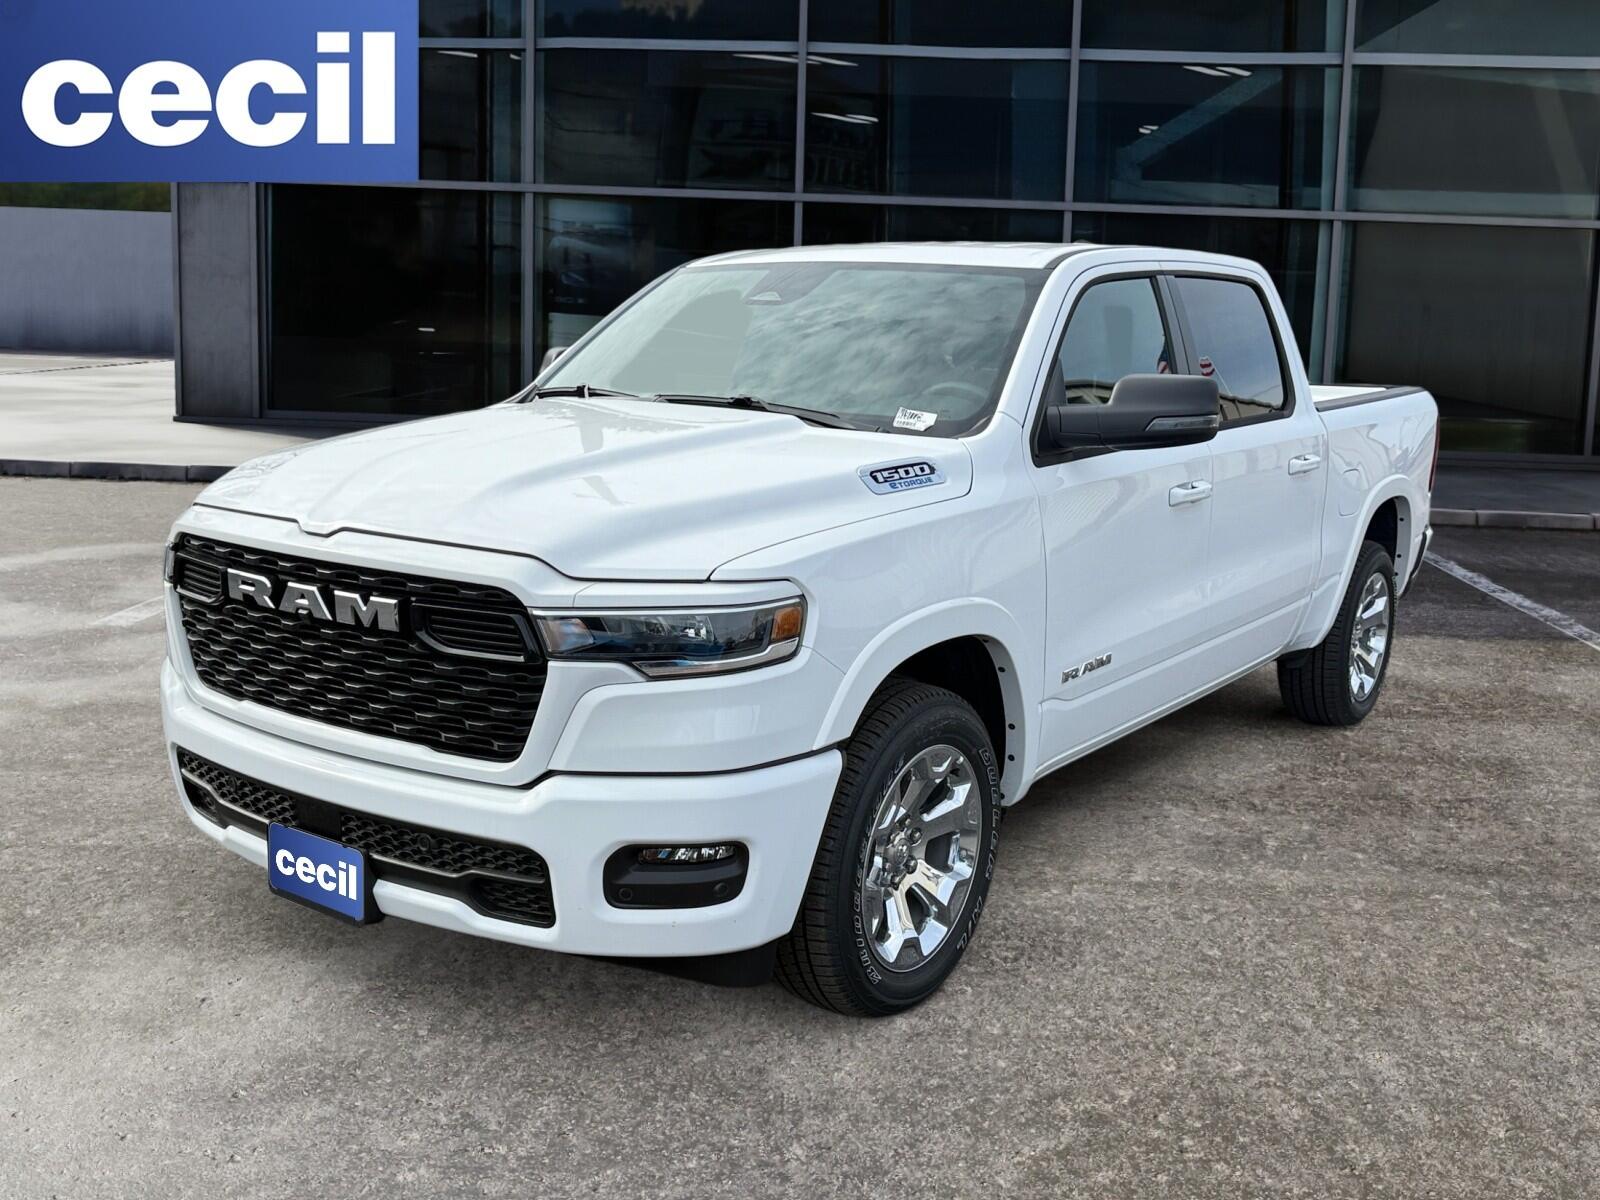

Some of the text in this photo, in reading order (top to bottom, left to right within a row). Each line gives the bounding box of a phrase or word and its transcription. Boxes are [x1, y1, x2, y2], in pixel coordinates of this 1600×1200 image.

[872, 464, 931, 483] 1500
[227, 568, 400, 632] RAM
[1061, 652, 1112, 684] RAM
[275, 849, 357, 900] cecil
